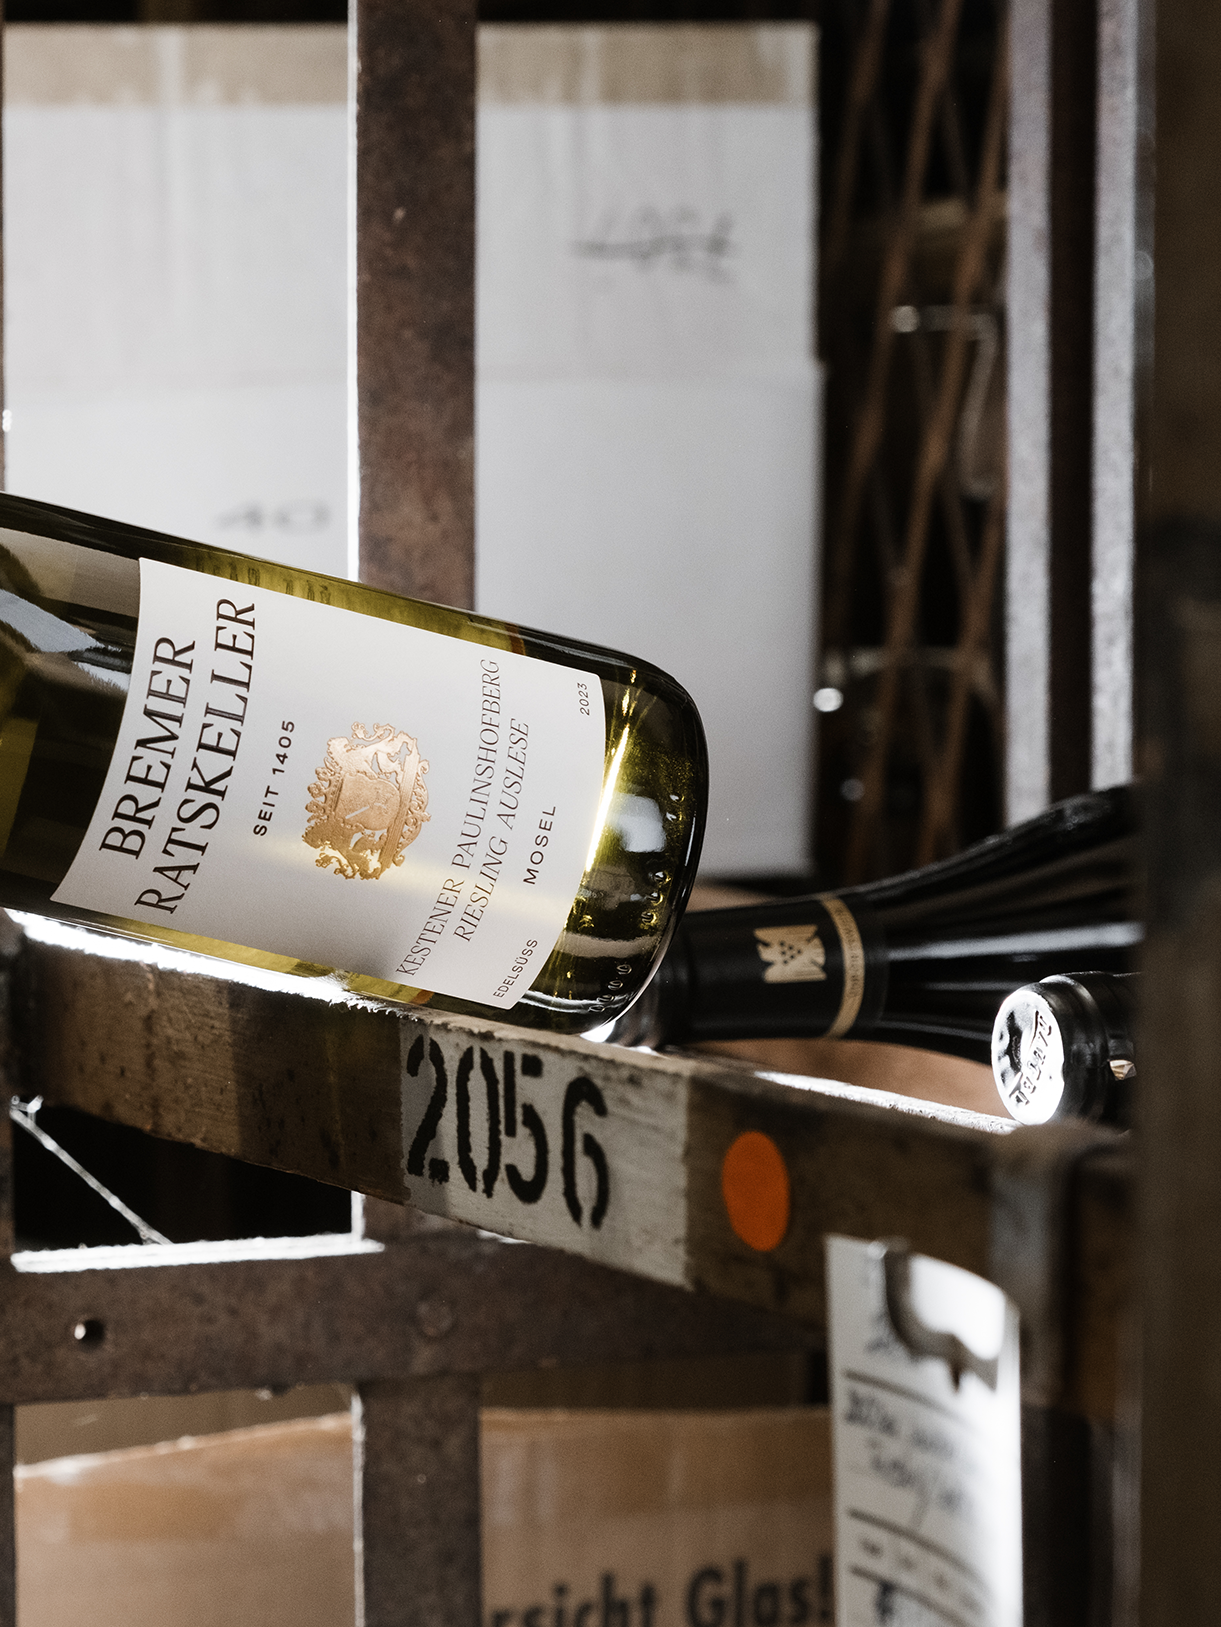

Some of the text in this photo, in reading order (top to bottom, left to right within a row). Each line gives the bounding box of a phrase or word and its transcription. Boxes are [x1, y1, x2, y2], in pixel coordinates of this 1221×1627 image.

[99, 636, 196, 860] BREMER
[133, 598, 256, 915] RATSKELLER
[253, 720, 296, 837] SEIT 1405
[576, 682, 590, 716] 2023
[395, 659, 501, 977] KESTENER PAULINSHOFBERG
[453, 717, 529, 942] RIESLING AUSLESE
[523, 804, 557, 885] MOSEL
[493, 938, 538, 999] EDELSÜSS
[406, 1034, 611, 1231] 2056
